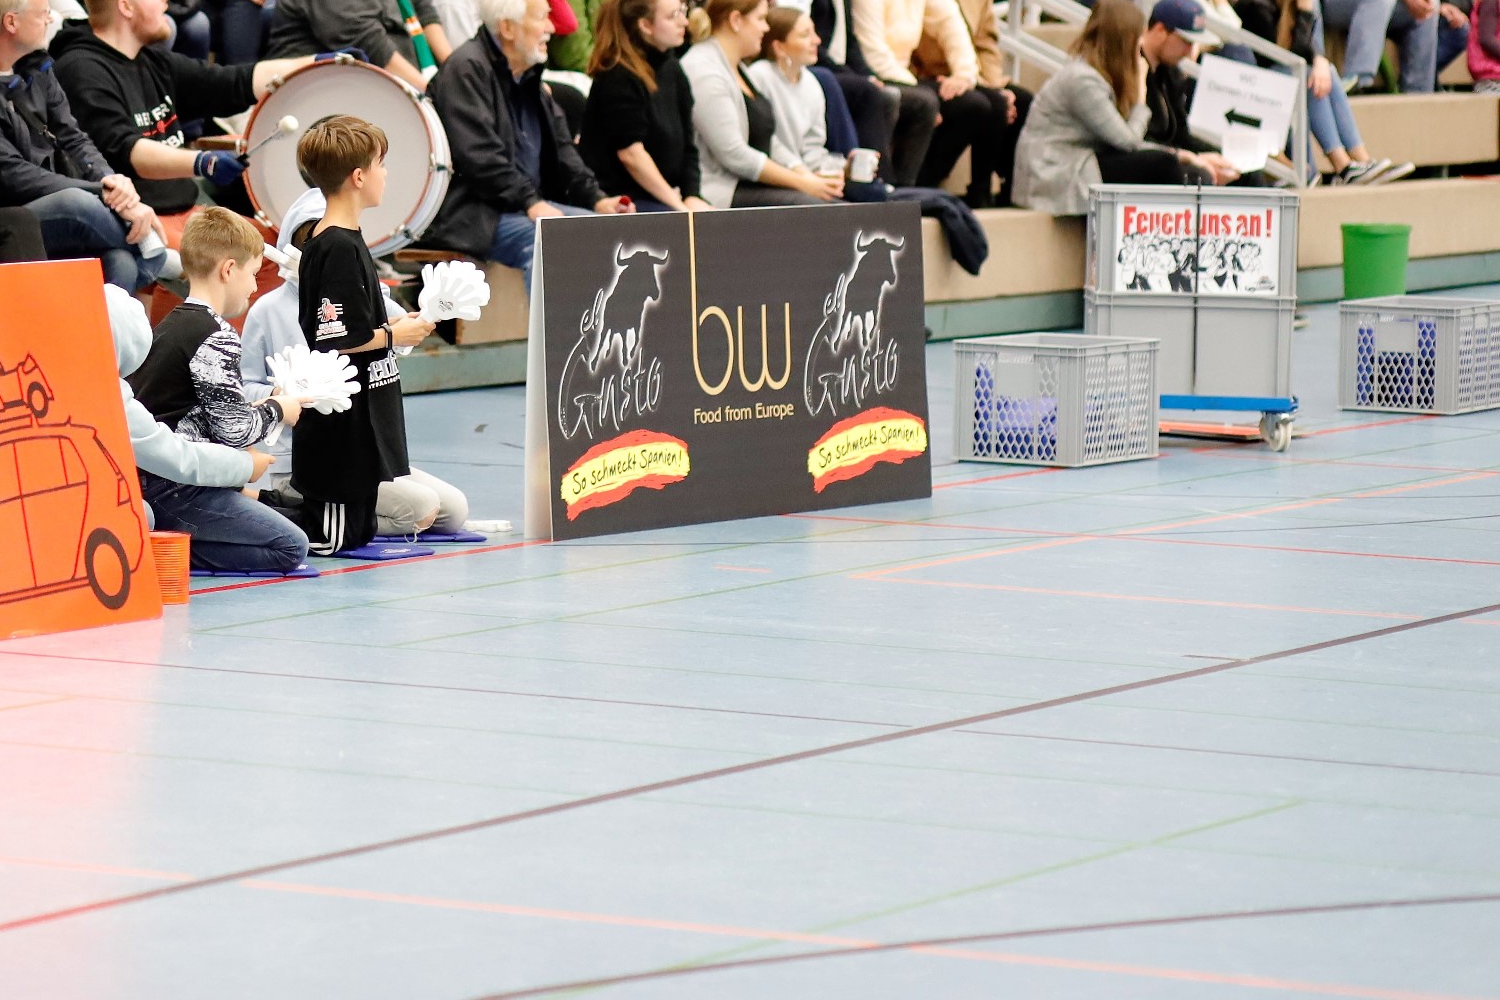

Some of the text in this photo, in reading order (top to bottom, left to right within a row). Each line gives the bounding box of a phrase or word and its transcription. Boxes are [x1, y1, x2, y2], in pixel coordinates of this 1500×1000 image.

[1199, 212, 1232, 237] uns
[694, 402, 795, 425] Food from Europe
[818, 425, 920, 469] So schmeckt Spanien!
[572, 448, 683, 495] So schmeckt Spanien!
